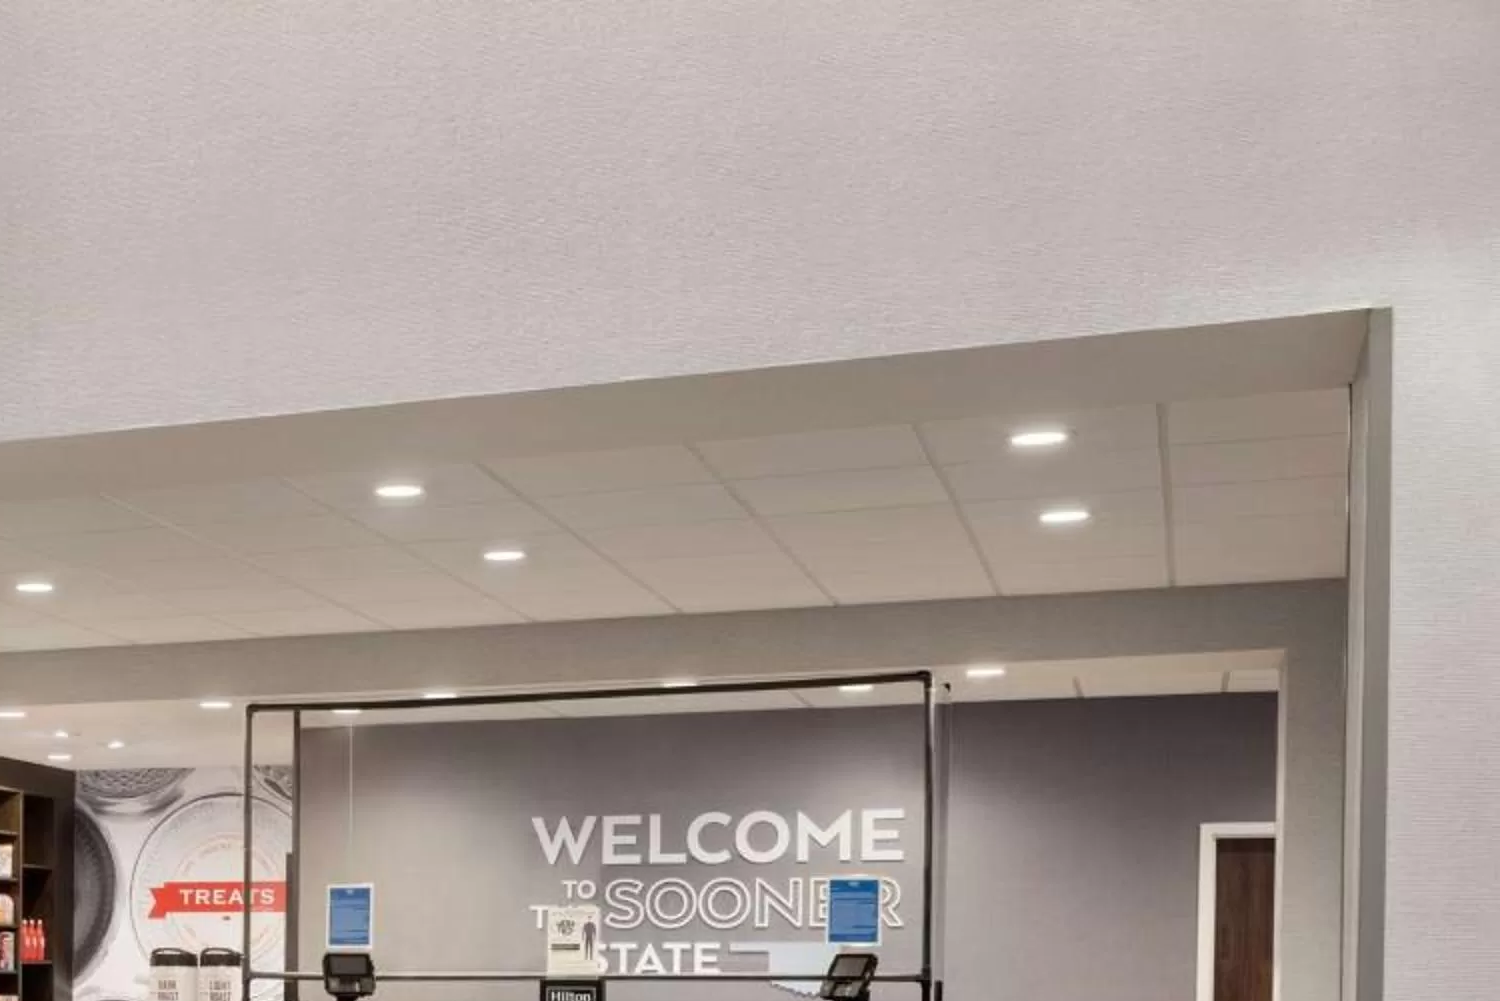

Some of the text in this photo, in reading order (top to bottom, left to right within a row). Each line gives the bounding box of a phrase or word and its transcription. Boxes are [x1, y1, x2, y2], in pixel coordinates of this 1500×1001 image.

[531, 808, 905, 865] WELCOME
[180, 888, 276, 906] TREATS
[562, 879, 597, 900] TO
